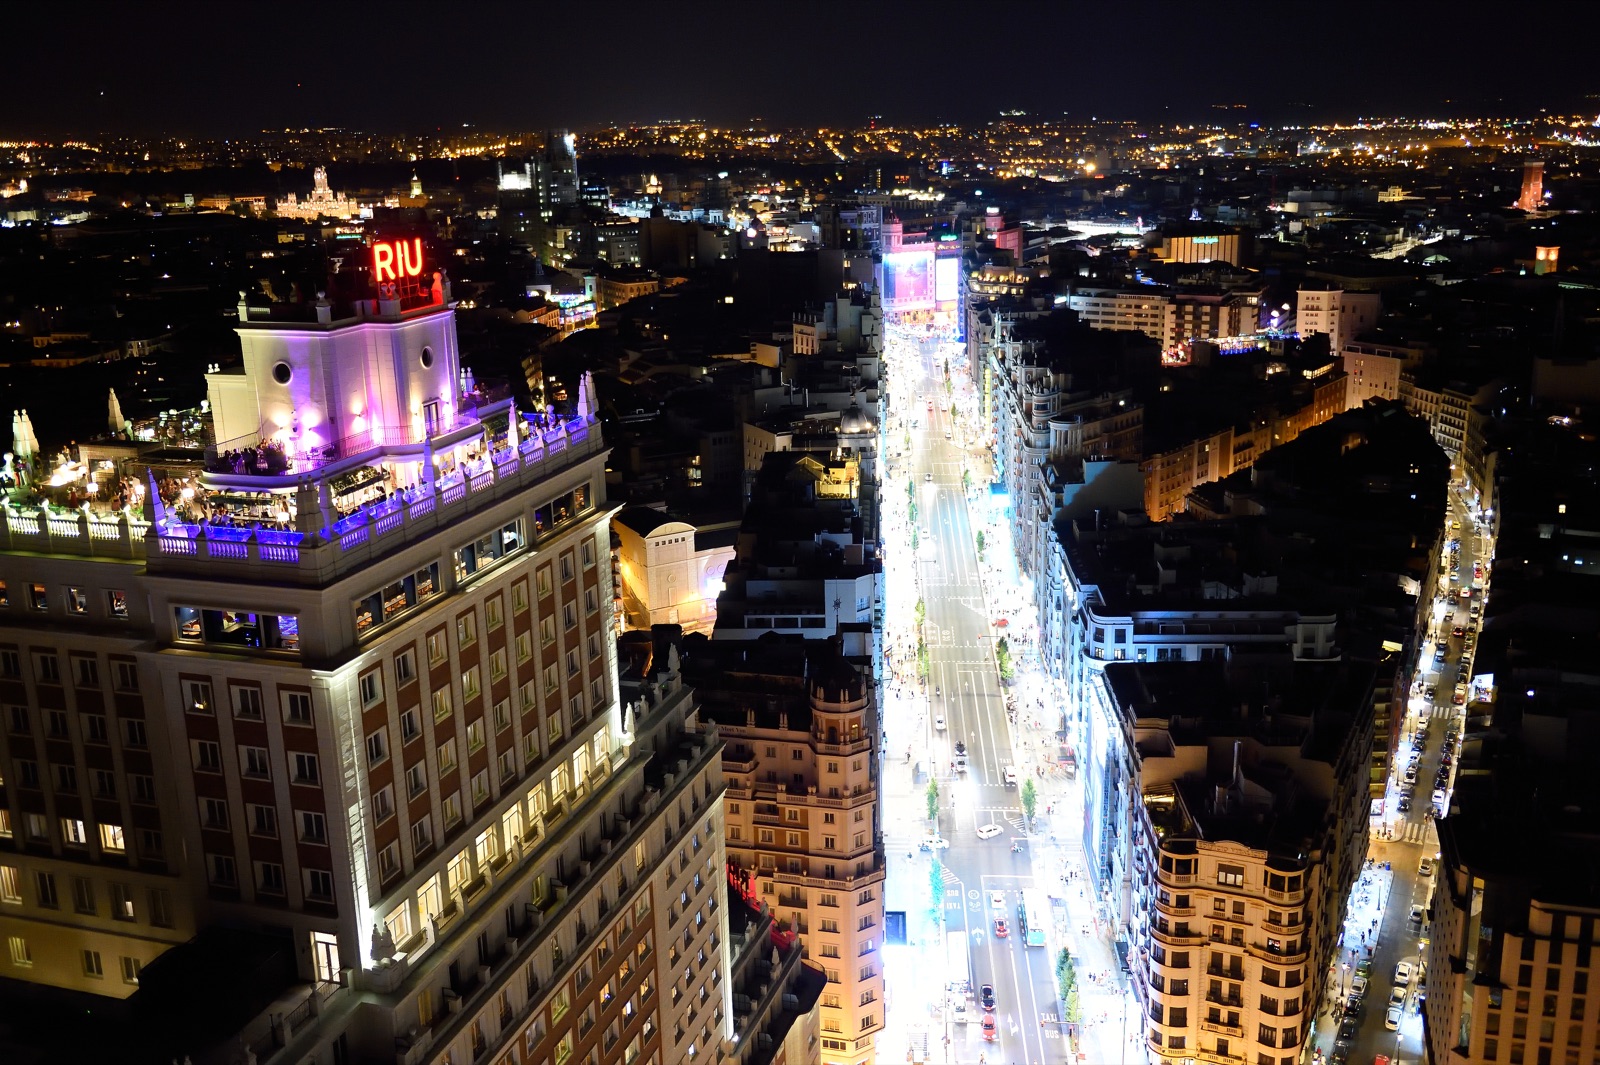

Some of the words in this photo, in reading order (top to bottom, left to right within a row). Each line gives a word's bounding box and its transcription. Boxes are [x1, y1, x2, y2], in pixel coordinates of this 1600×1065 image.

[373, 238, 422, 281] RIU
[1040, 1012, 1057, 1022] TAXI
[1044, 1029, 1060, 1038] BUS
